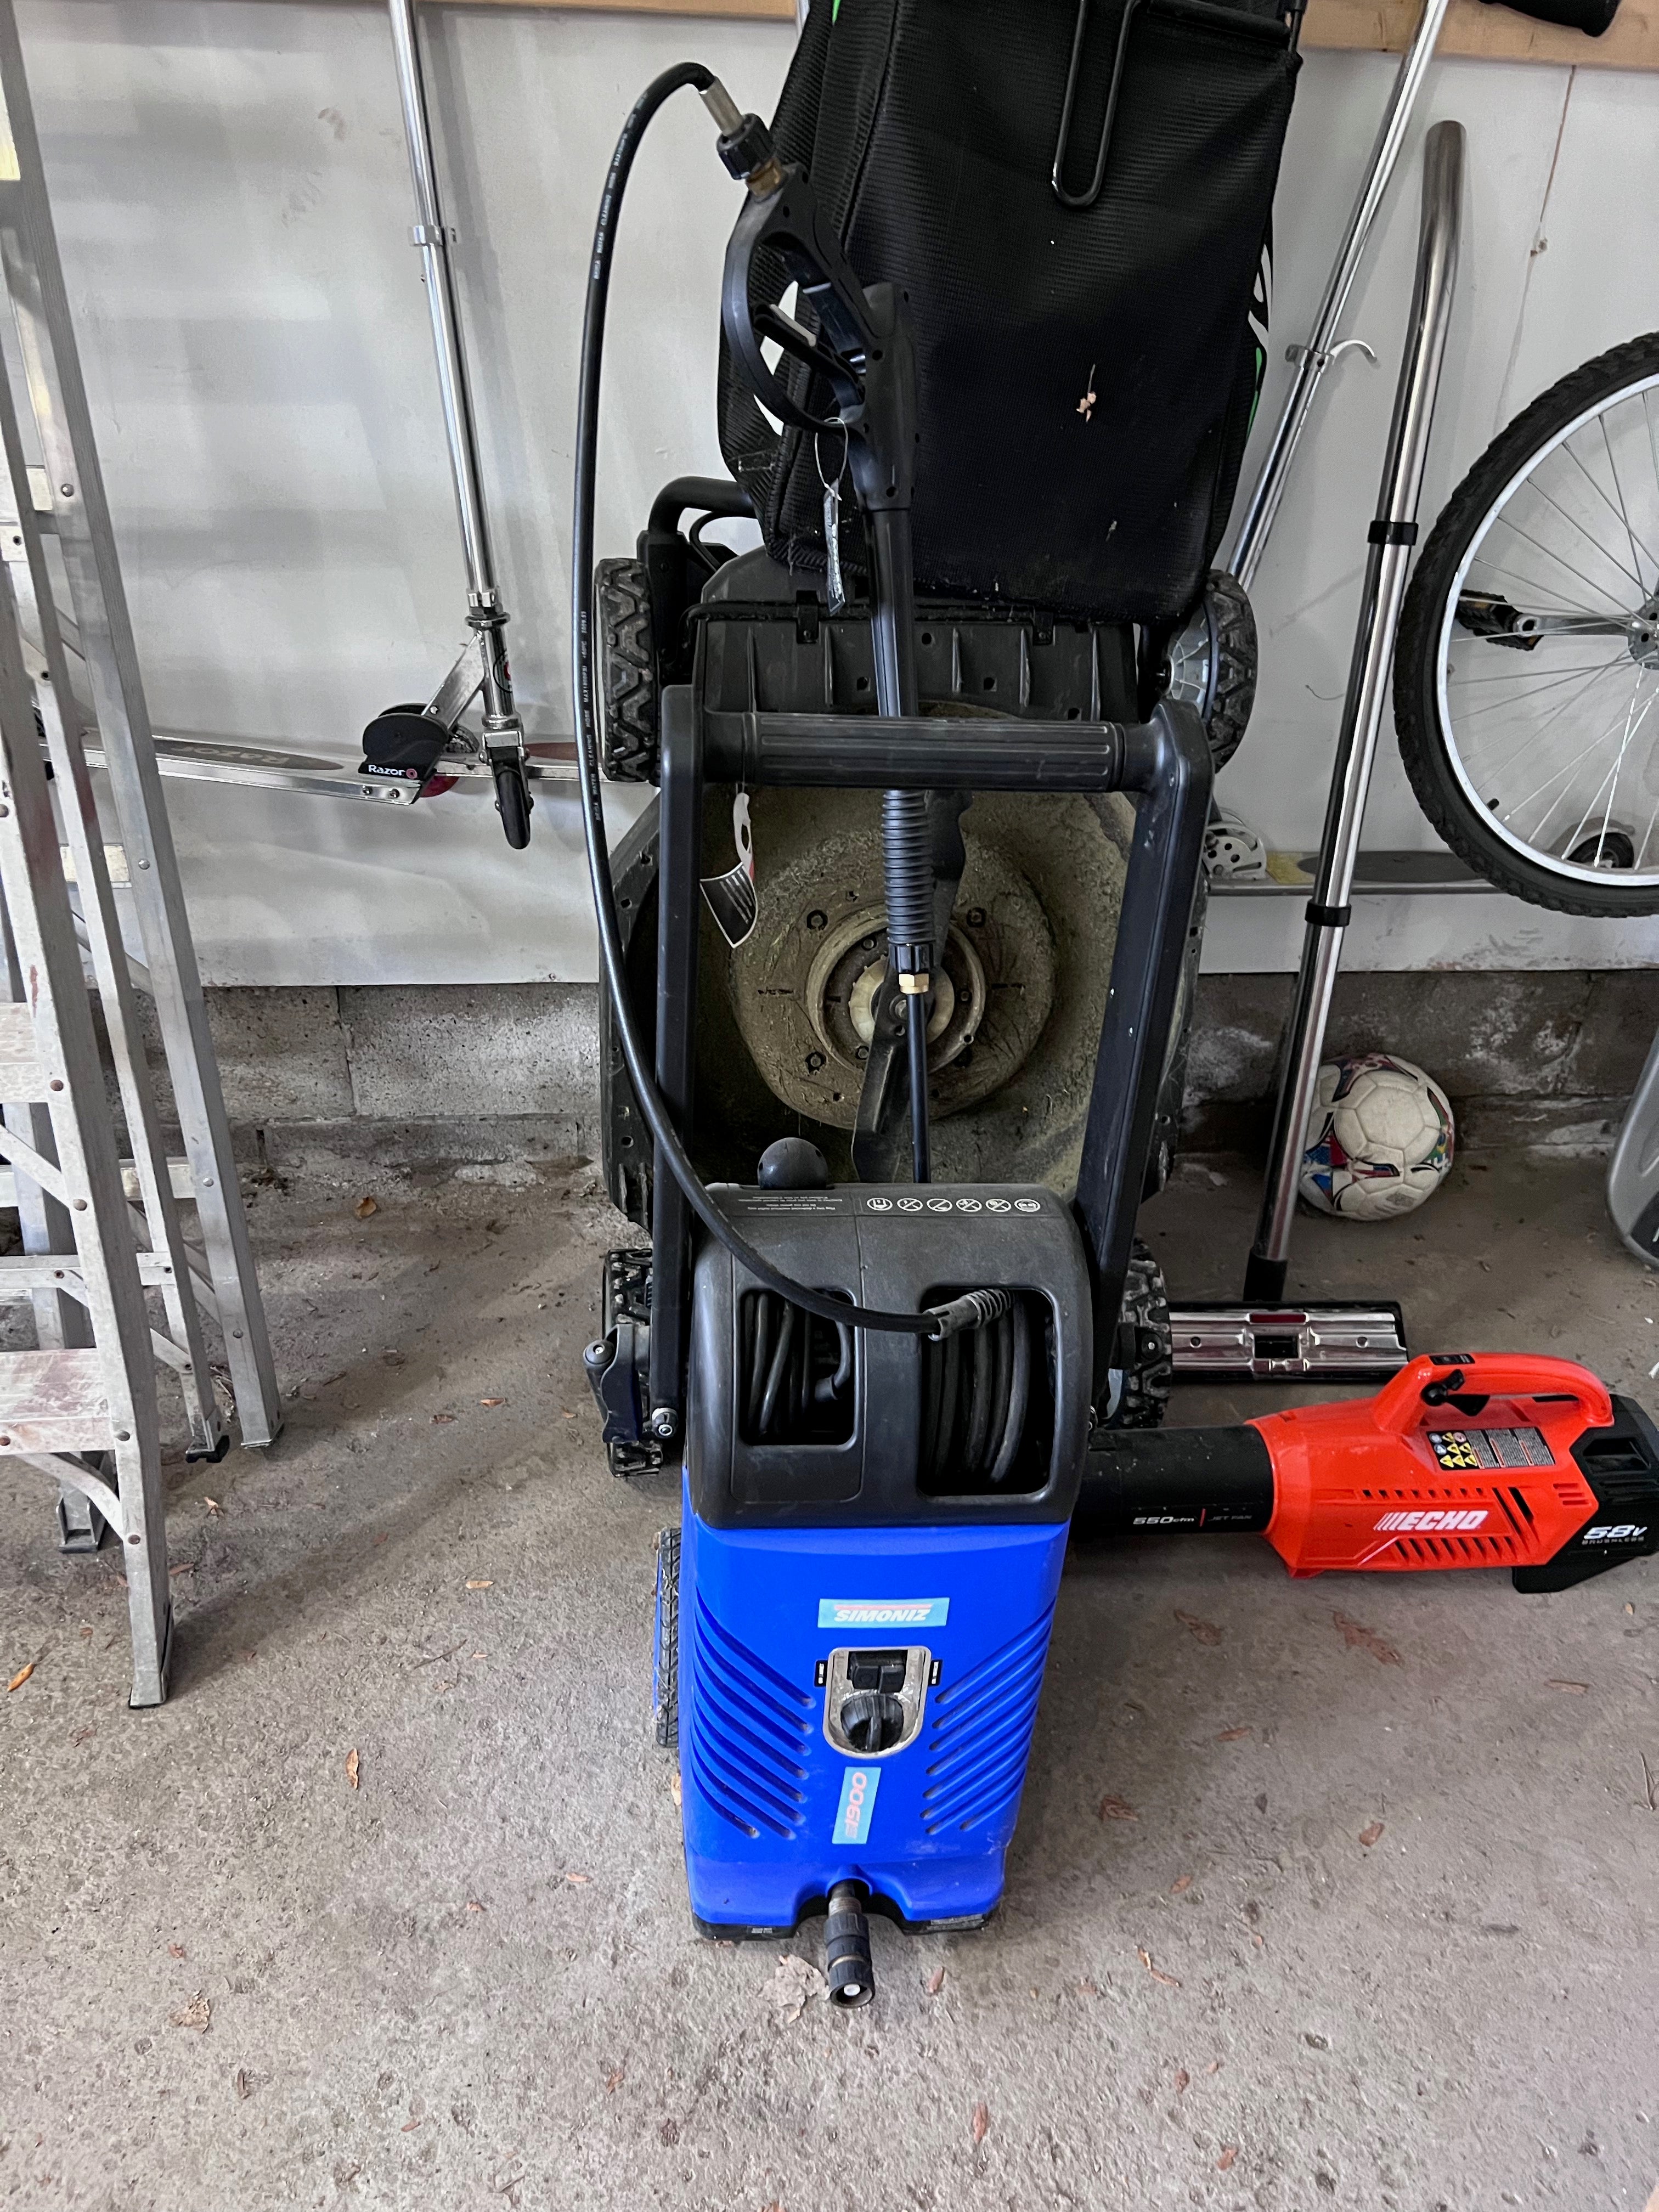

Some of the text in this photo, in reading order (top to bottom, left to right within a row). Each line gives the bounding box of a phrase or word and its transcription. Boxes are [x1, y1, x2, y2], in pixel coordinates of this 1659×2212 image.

[368, 764, 405, 776] Razor
[1397, 1510, 1488, 1531] ECHO
[834, 1609, 930, 1622] SIMONIZ
